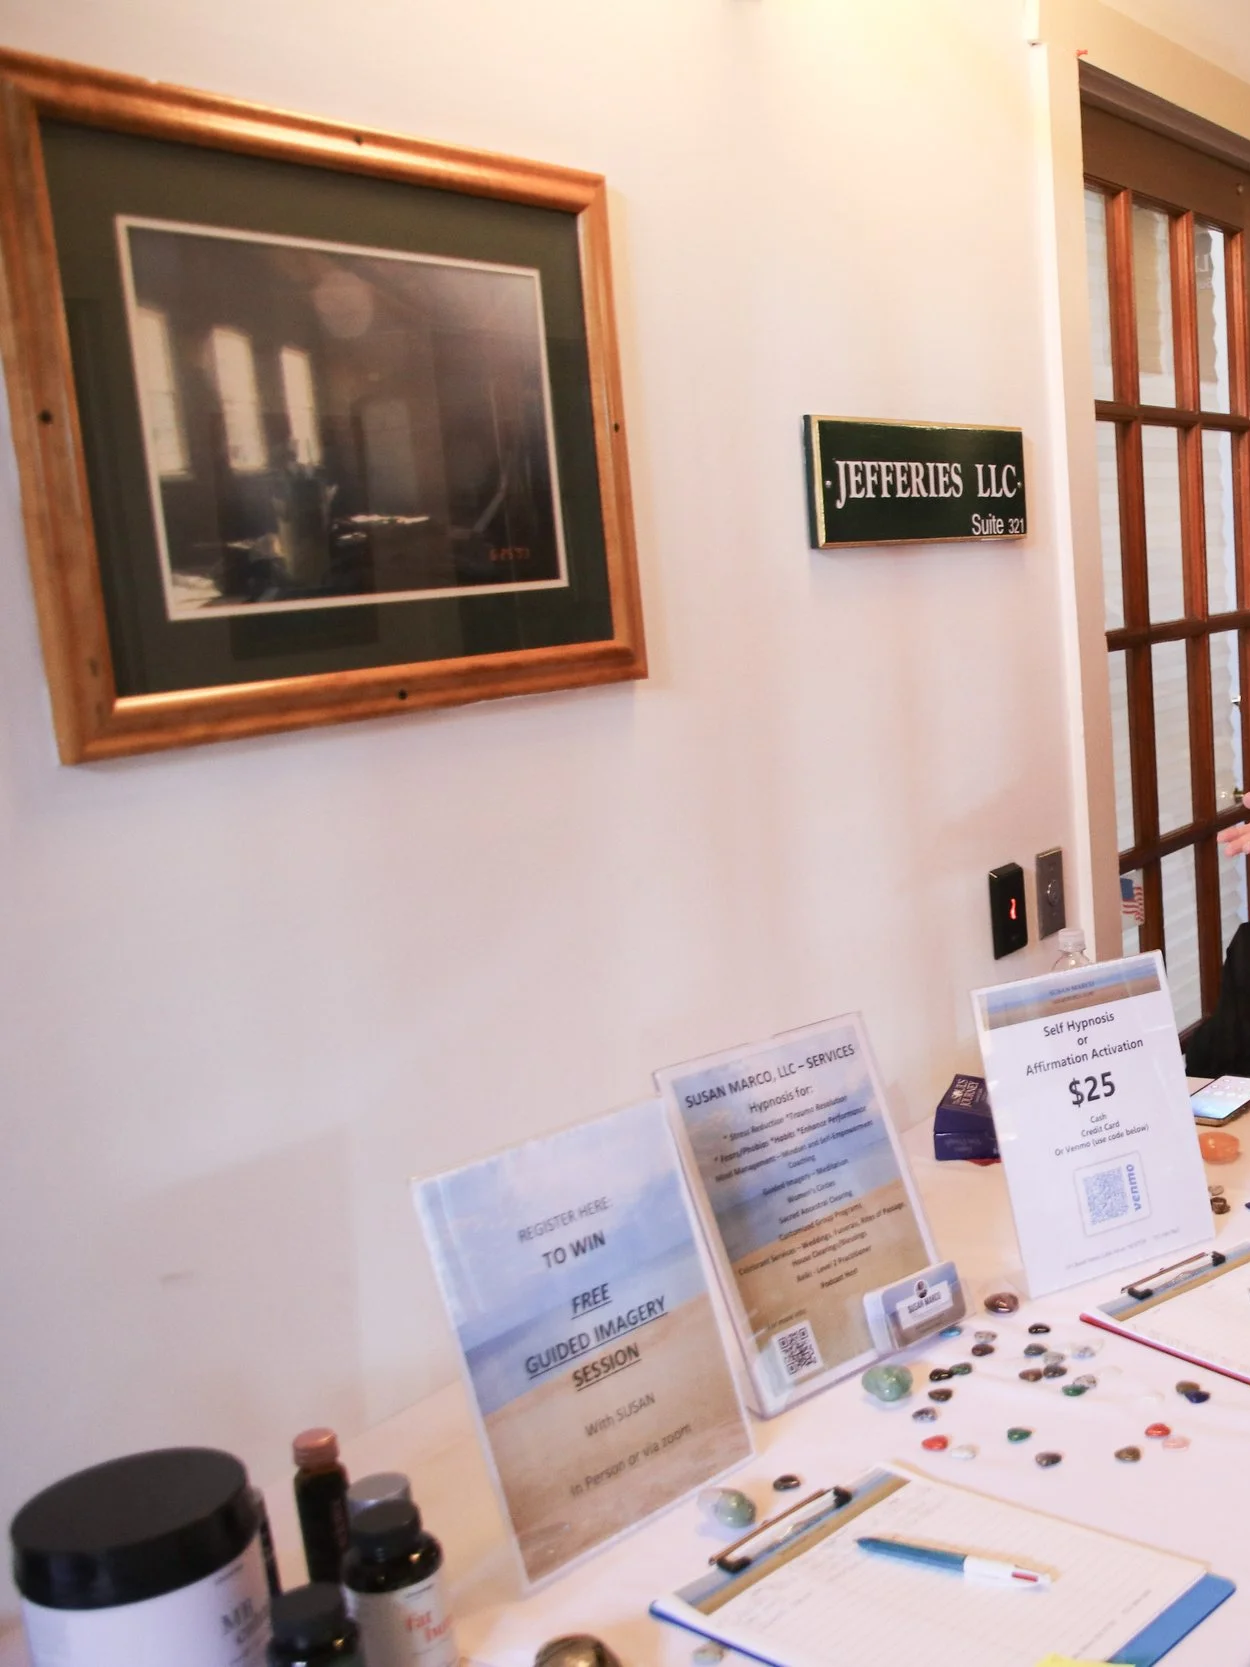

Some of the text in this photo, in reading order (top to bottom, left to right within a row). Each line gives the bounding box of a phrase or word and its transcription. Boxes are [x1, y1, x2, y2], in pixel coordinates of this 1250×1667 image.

[835, 460, 1017, 509] JEFFERIES LLC
[971, 513, 1025, 535] Suite 321
[1043, 1011, 1115, 1037] Self Hypnosis
[1077, 1035, 1088, 1046] or
[685, 1086, 727, 1108] SUSAN
[728, 1070, 776, 1094] MARCO,
[777, 1062, 797, 1079] LLC
[806, 1043, 855, 1069] SERVICES
[1026, 1038, 1144, 1076] Affirmation Activation
[749, 1084, 813, 1115] Hypnosis for:
[1068, 1071, 1116, 1108] $25
[1081, 1120, 1120, 1138] Credit Card
[1090, 1113, 1107, 1124] Cash
[1054, 1123, 1149, 1156] Or Venmo (use code below)
[1126, 1163, 1142, 1212] venmo
[517, 1210, 575, 1243] REGISTER
[542, 1229, 606, 1269] TO WIN
[571, 1282, 611, 1315] FREE
[525, 1295, 666, 1375] GUIDED IMAGERY
[572, 1342, 641, 1388] SESSION
[584, 1392, 656, 1437] With SUSAN
[584, 1460, 626, 1490] Person
[628, 1451, 641, 1466] or
[643, 1439, 660, 1458] via
[661, 1422, 692, 1447] zoom
